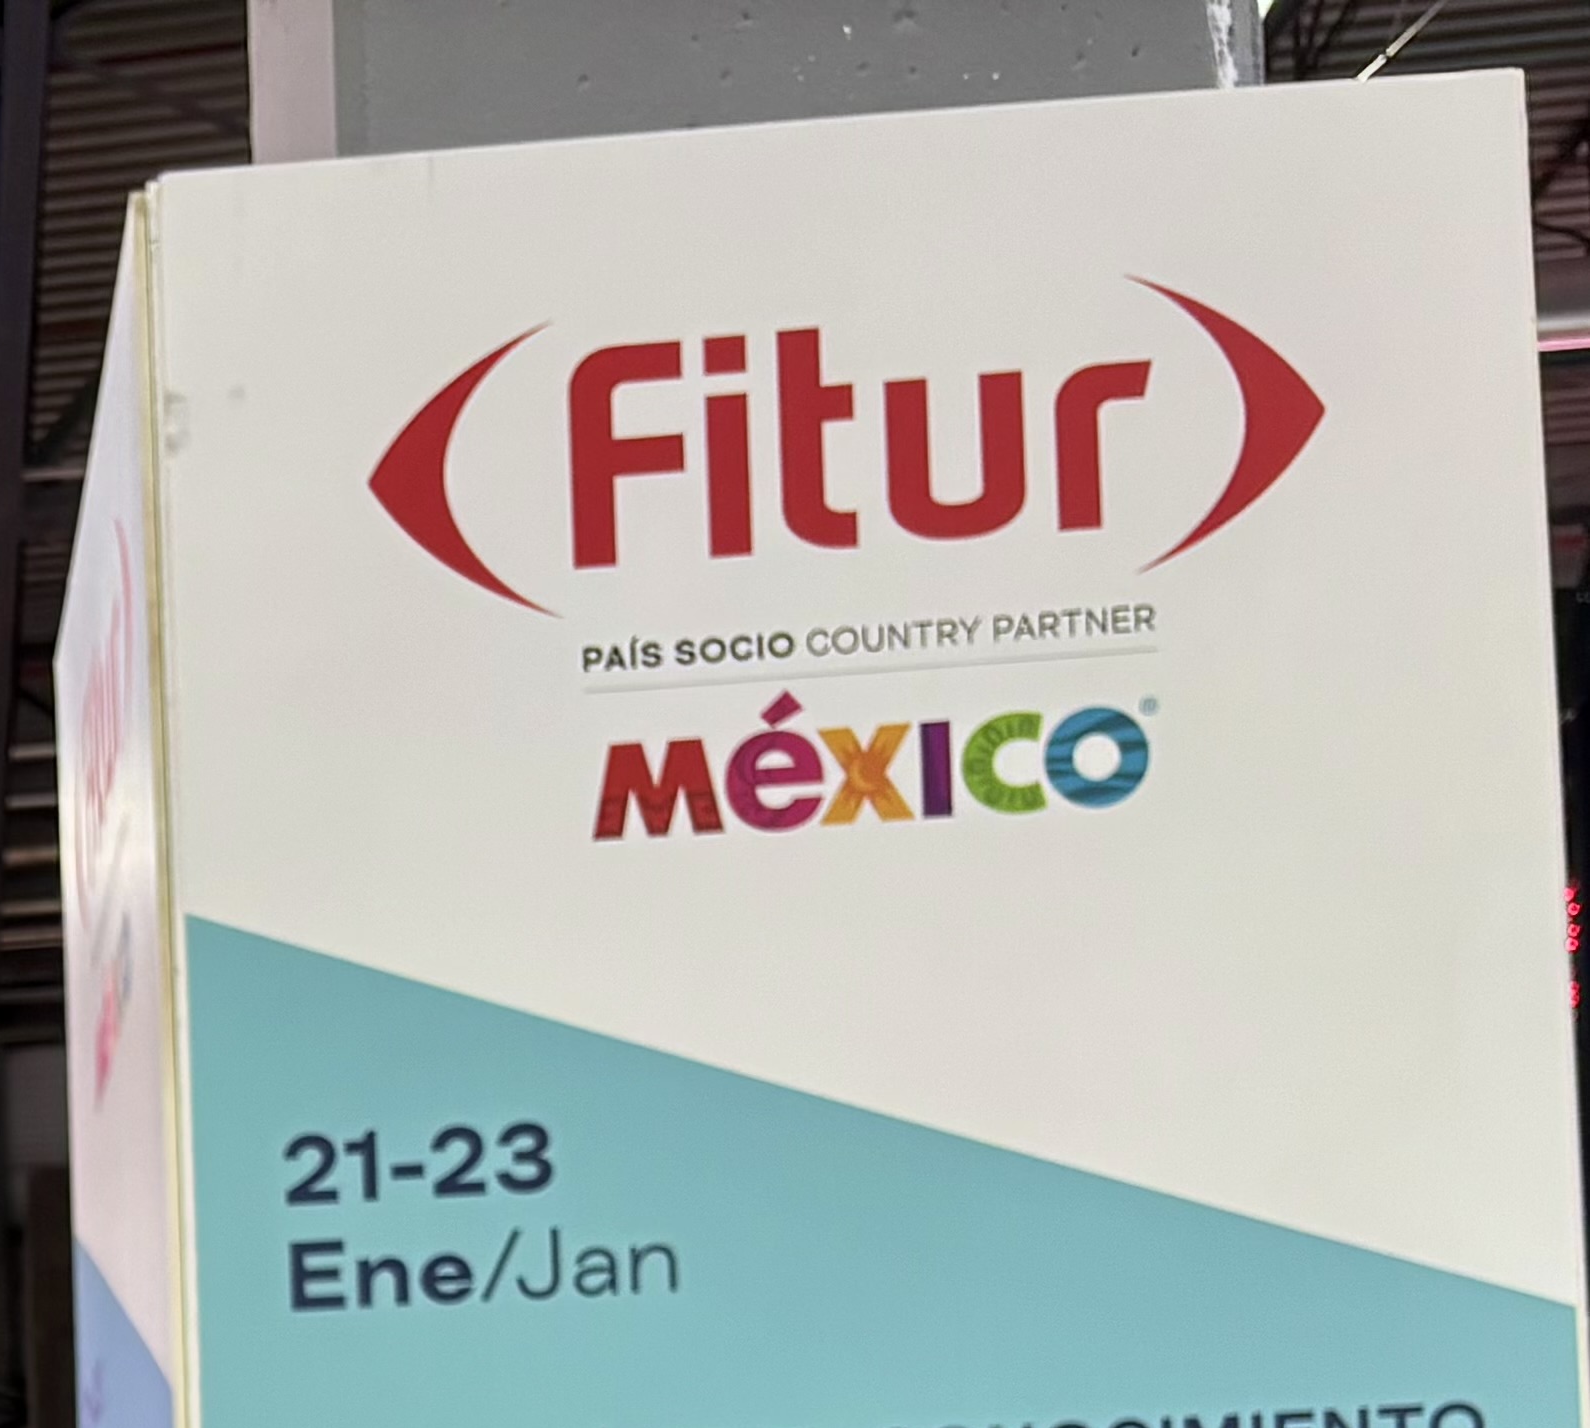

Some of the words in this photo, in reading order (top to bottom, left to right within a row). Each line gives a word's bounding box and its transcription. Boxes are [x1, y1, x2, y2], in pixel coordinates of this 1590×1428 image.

[566, 325, 1152, 570] Fitur
[580, 636, 663, 673] PAÍS
[673, 630, 797, 666] SOCIO
[805, 616, 982, 660] COUNTRY
[991, 603, 1156, 645] PARTNER
[282, 1121, 557, 1206] 21-23
[287, 1226, 682, 1313] Ene/Jan
